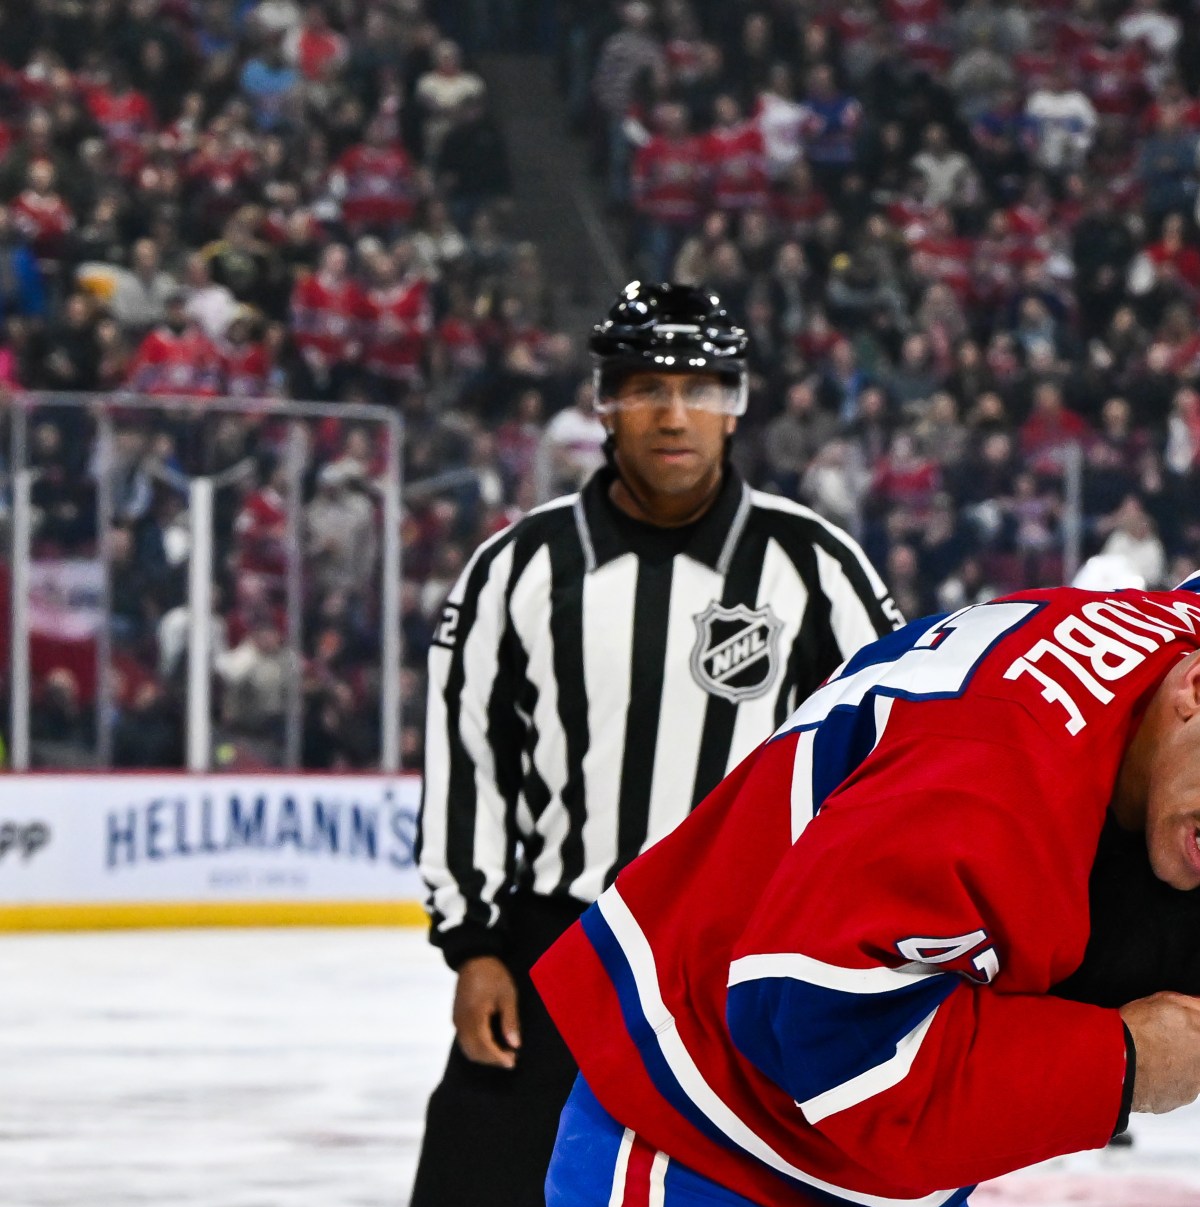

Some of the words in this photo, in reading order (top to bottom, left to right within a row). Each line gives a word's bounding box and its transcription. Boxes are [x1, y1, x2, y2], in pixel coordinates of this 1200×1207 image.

[433, 606, 460, 646] 2
[711, 630, 767, 678] NHL
[105, 790, 419, 872] HELLMANN'S
